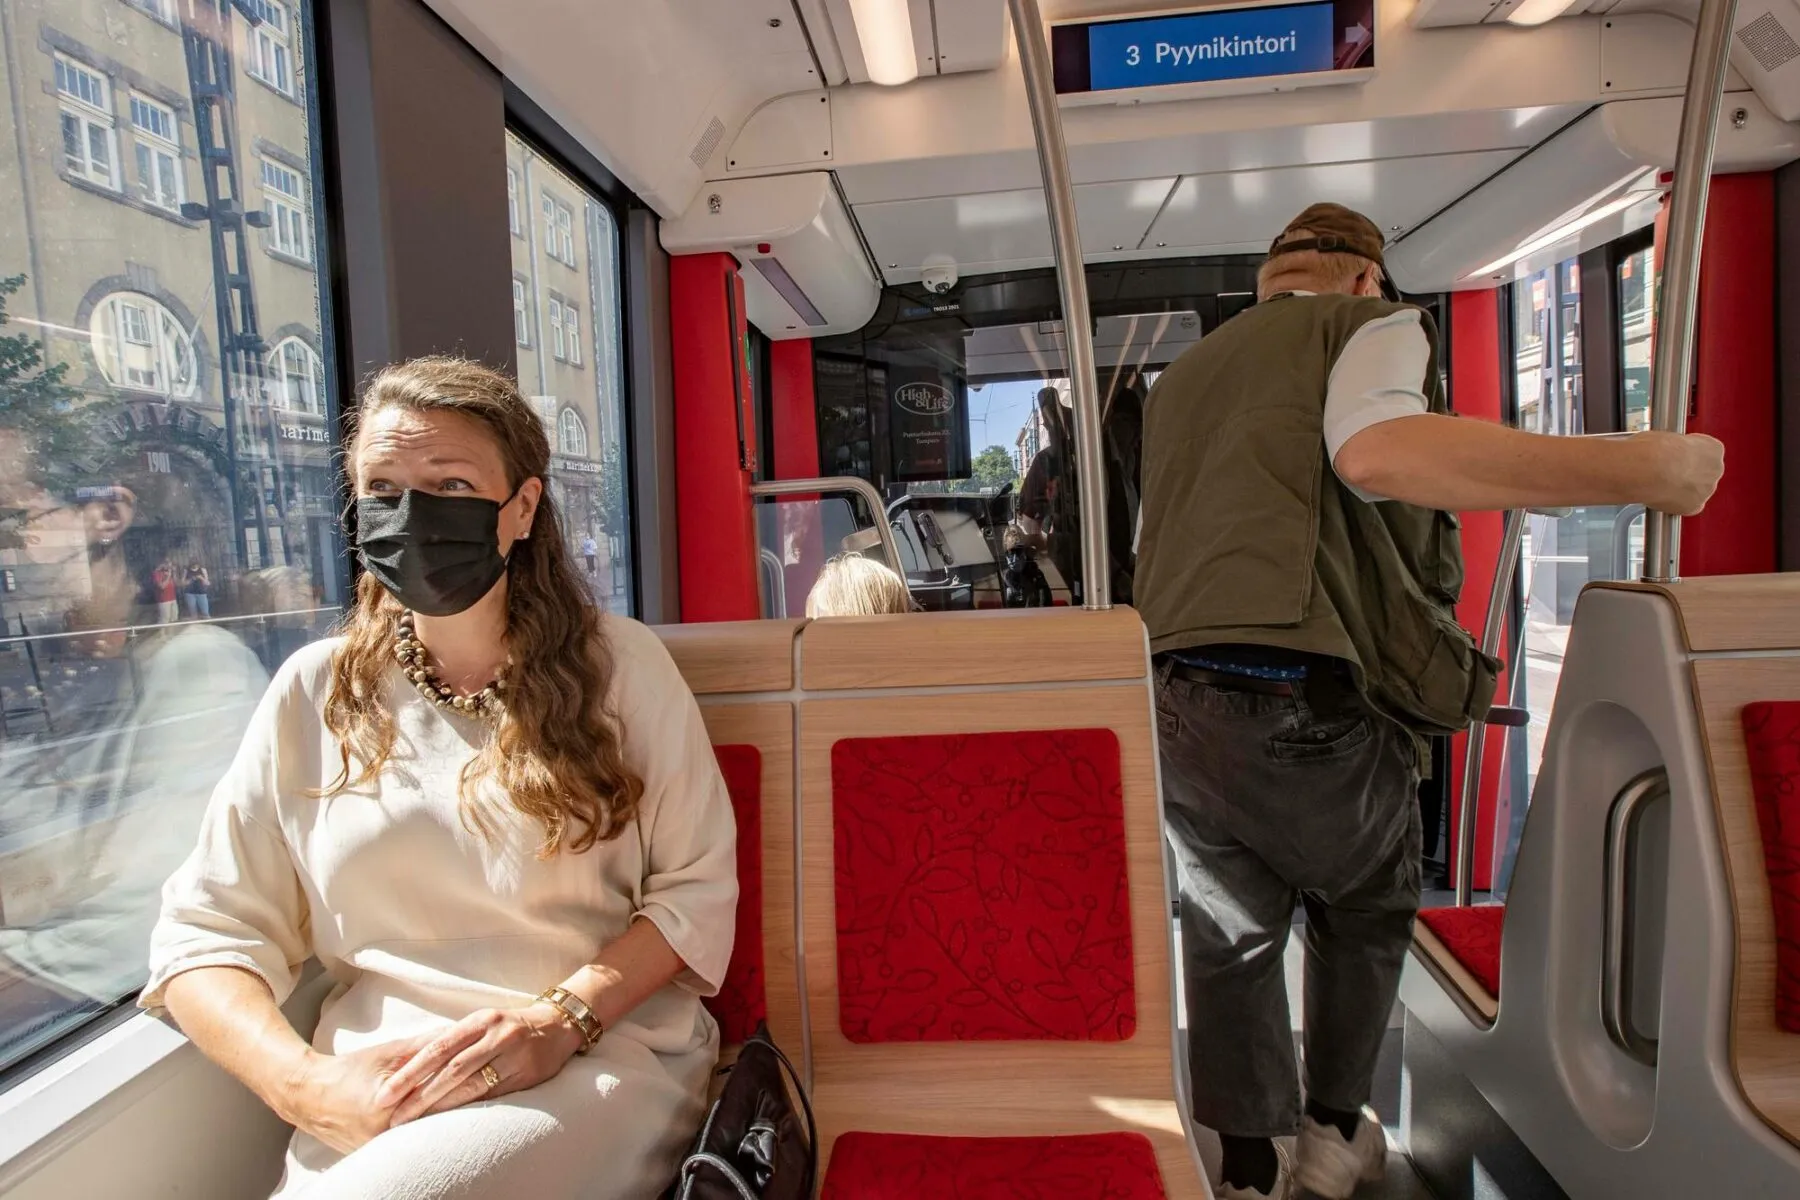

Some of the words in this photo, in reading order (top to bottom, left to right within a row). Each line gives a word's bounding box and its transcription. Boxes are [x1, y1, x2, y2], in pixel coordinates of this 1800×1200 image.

[1126, 46, 1141, 66] 3
[1156, 31, 1296, 66] Pyynikintori
[901, 387, 931, 402] High
[147, 452, 171, 473] 1901
